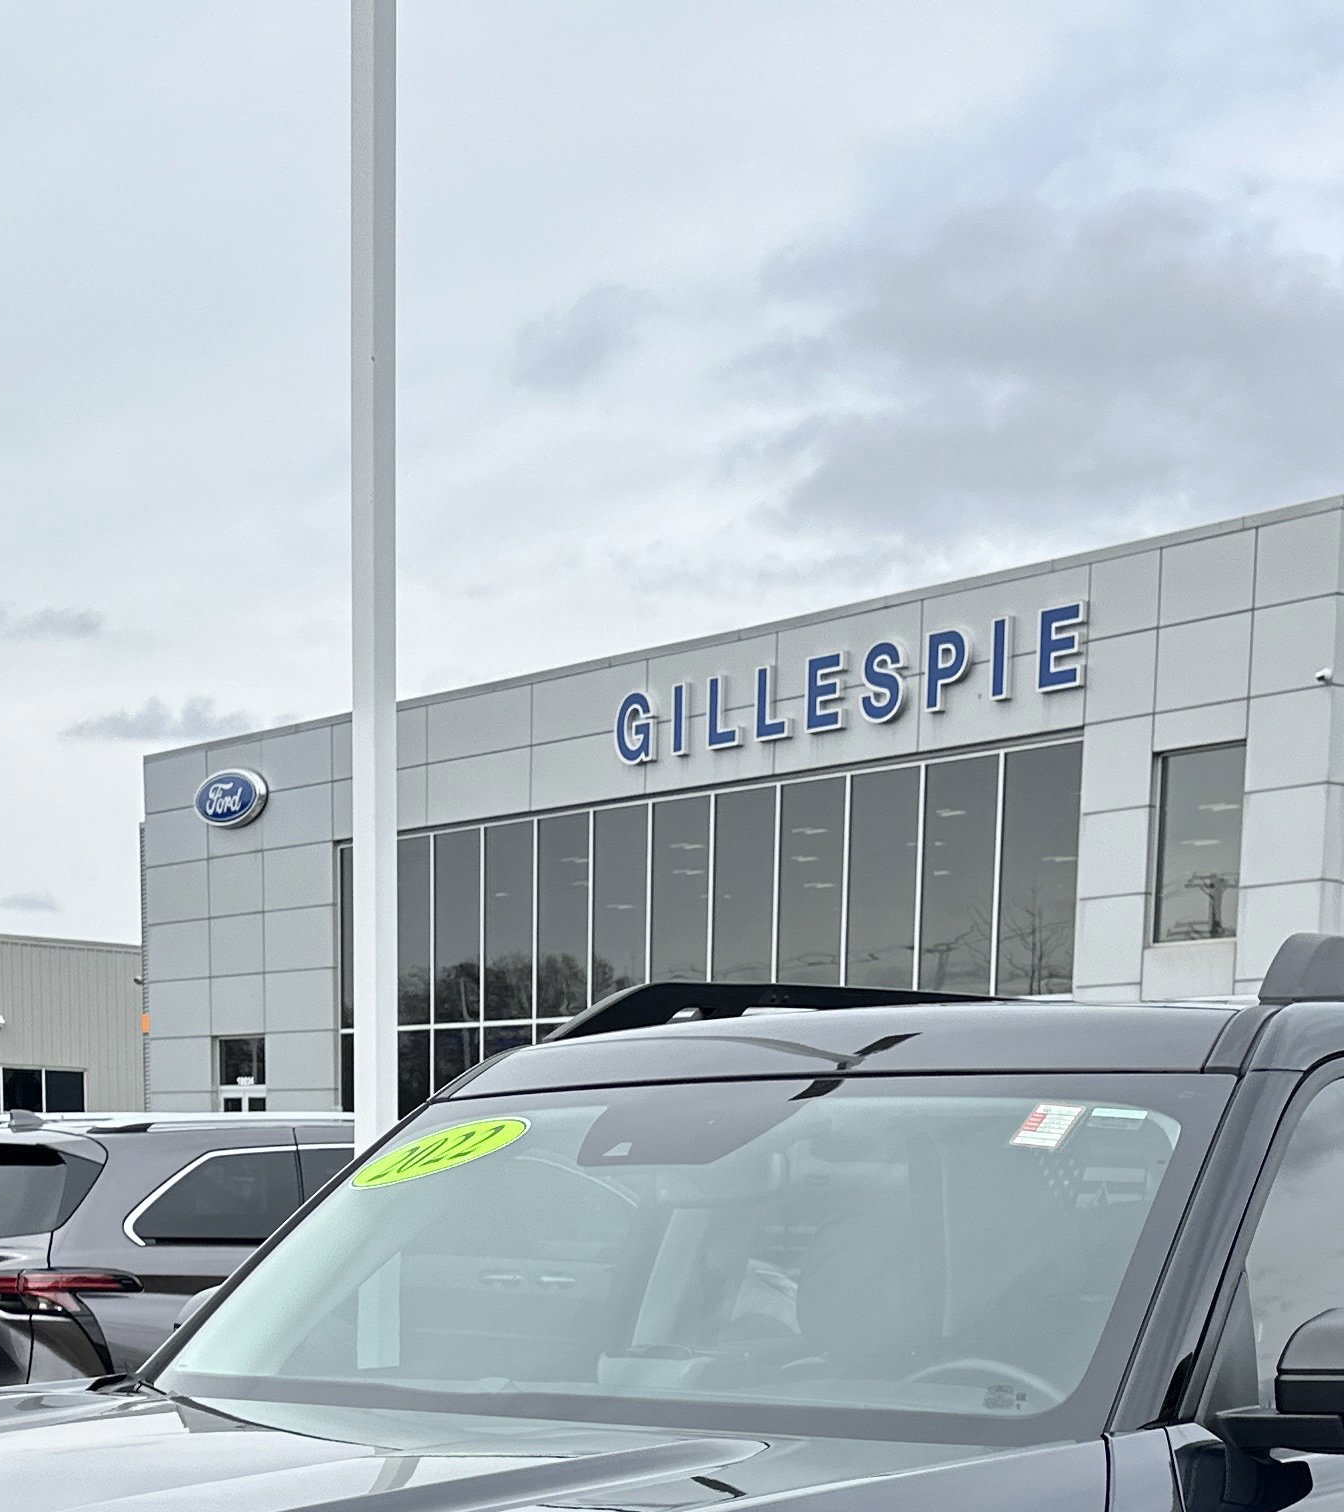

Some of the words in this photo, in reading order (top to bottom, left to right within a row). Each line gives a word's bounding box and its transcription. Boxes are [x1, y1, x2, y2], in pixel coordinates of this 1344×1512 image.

[614, 601, 1088, 765] GILLESPIE
[205, 782, 243, 816] Ford
[365, 1124, 507, 1183] 2022
